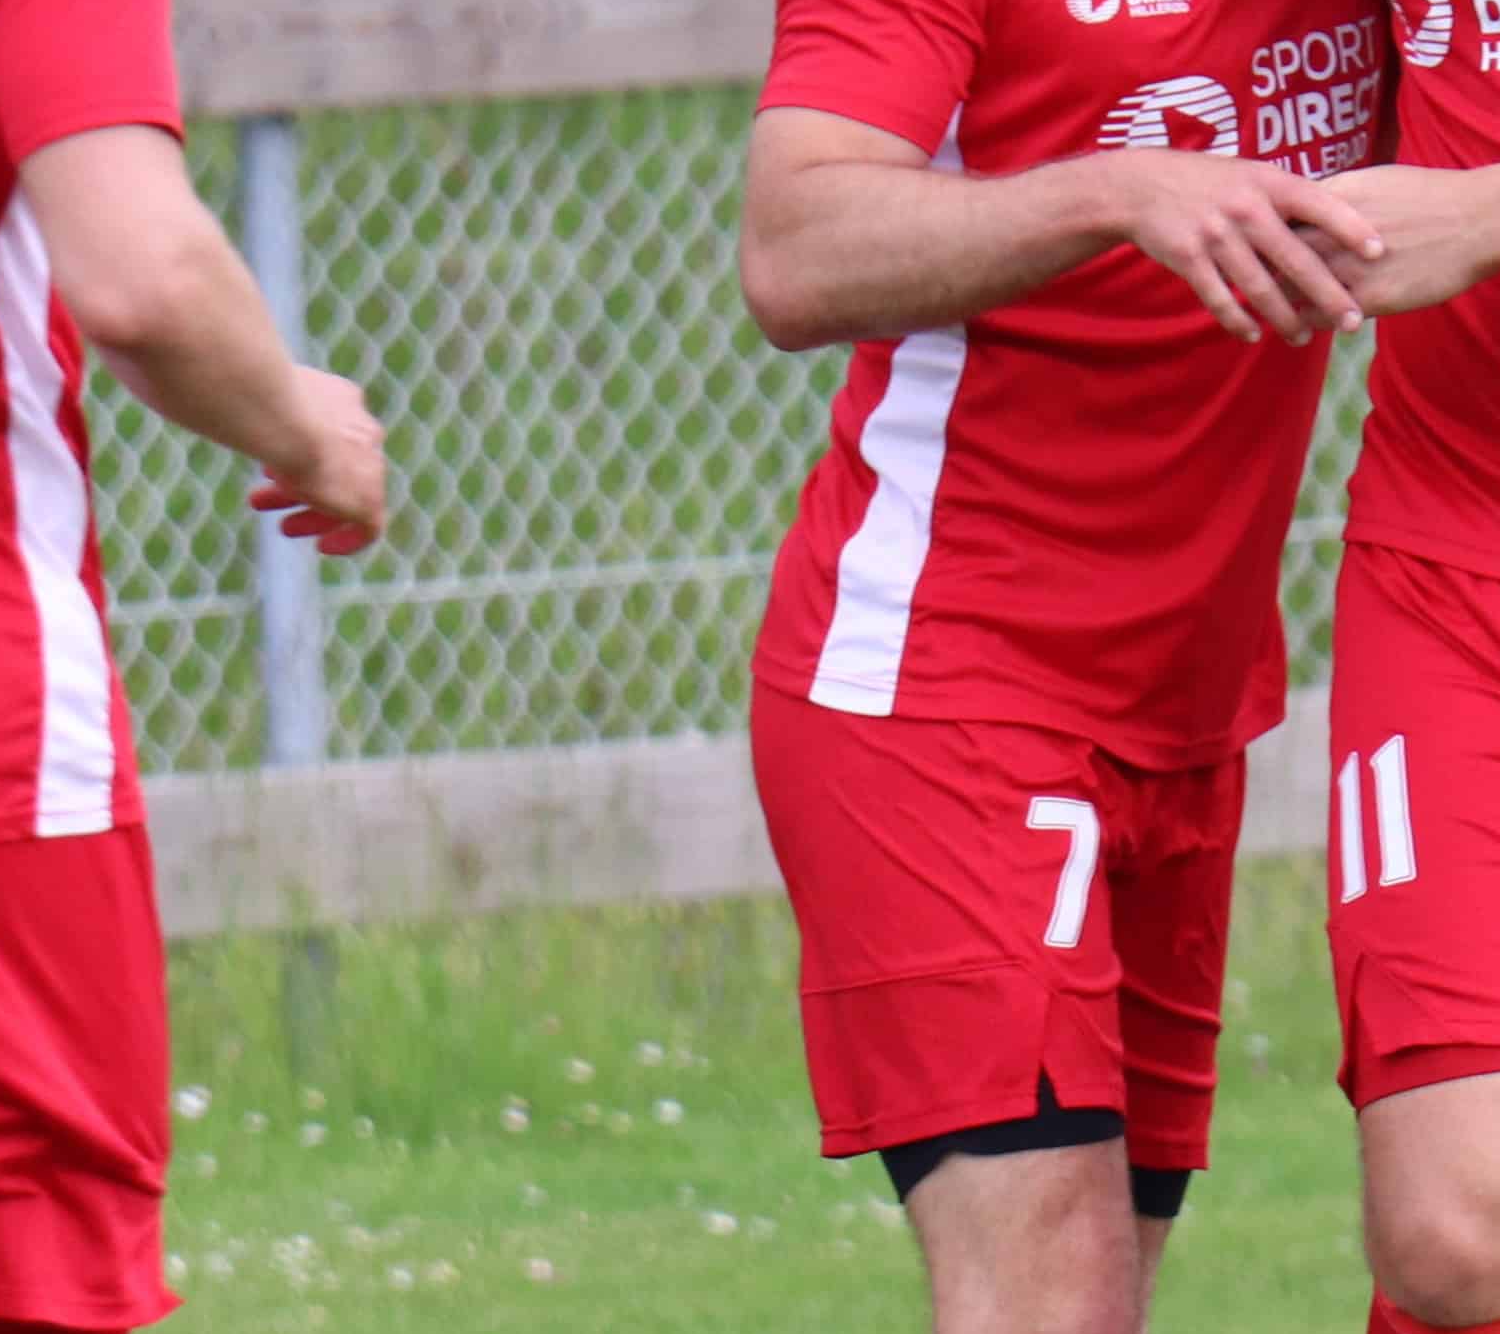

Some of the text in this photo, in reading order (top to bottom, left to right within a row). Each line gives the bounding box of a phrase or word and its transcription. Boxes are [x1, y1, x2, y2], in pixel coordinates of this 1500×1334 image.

[1251, 16, 1376, 97] SPORT
[1026, 796, 1100, 949] 7
[1337, 734, 1417, 904] 11
